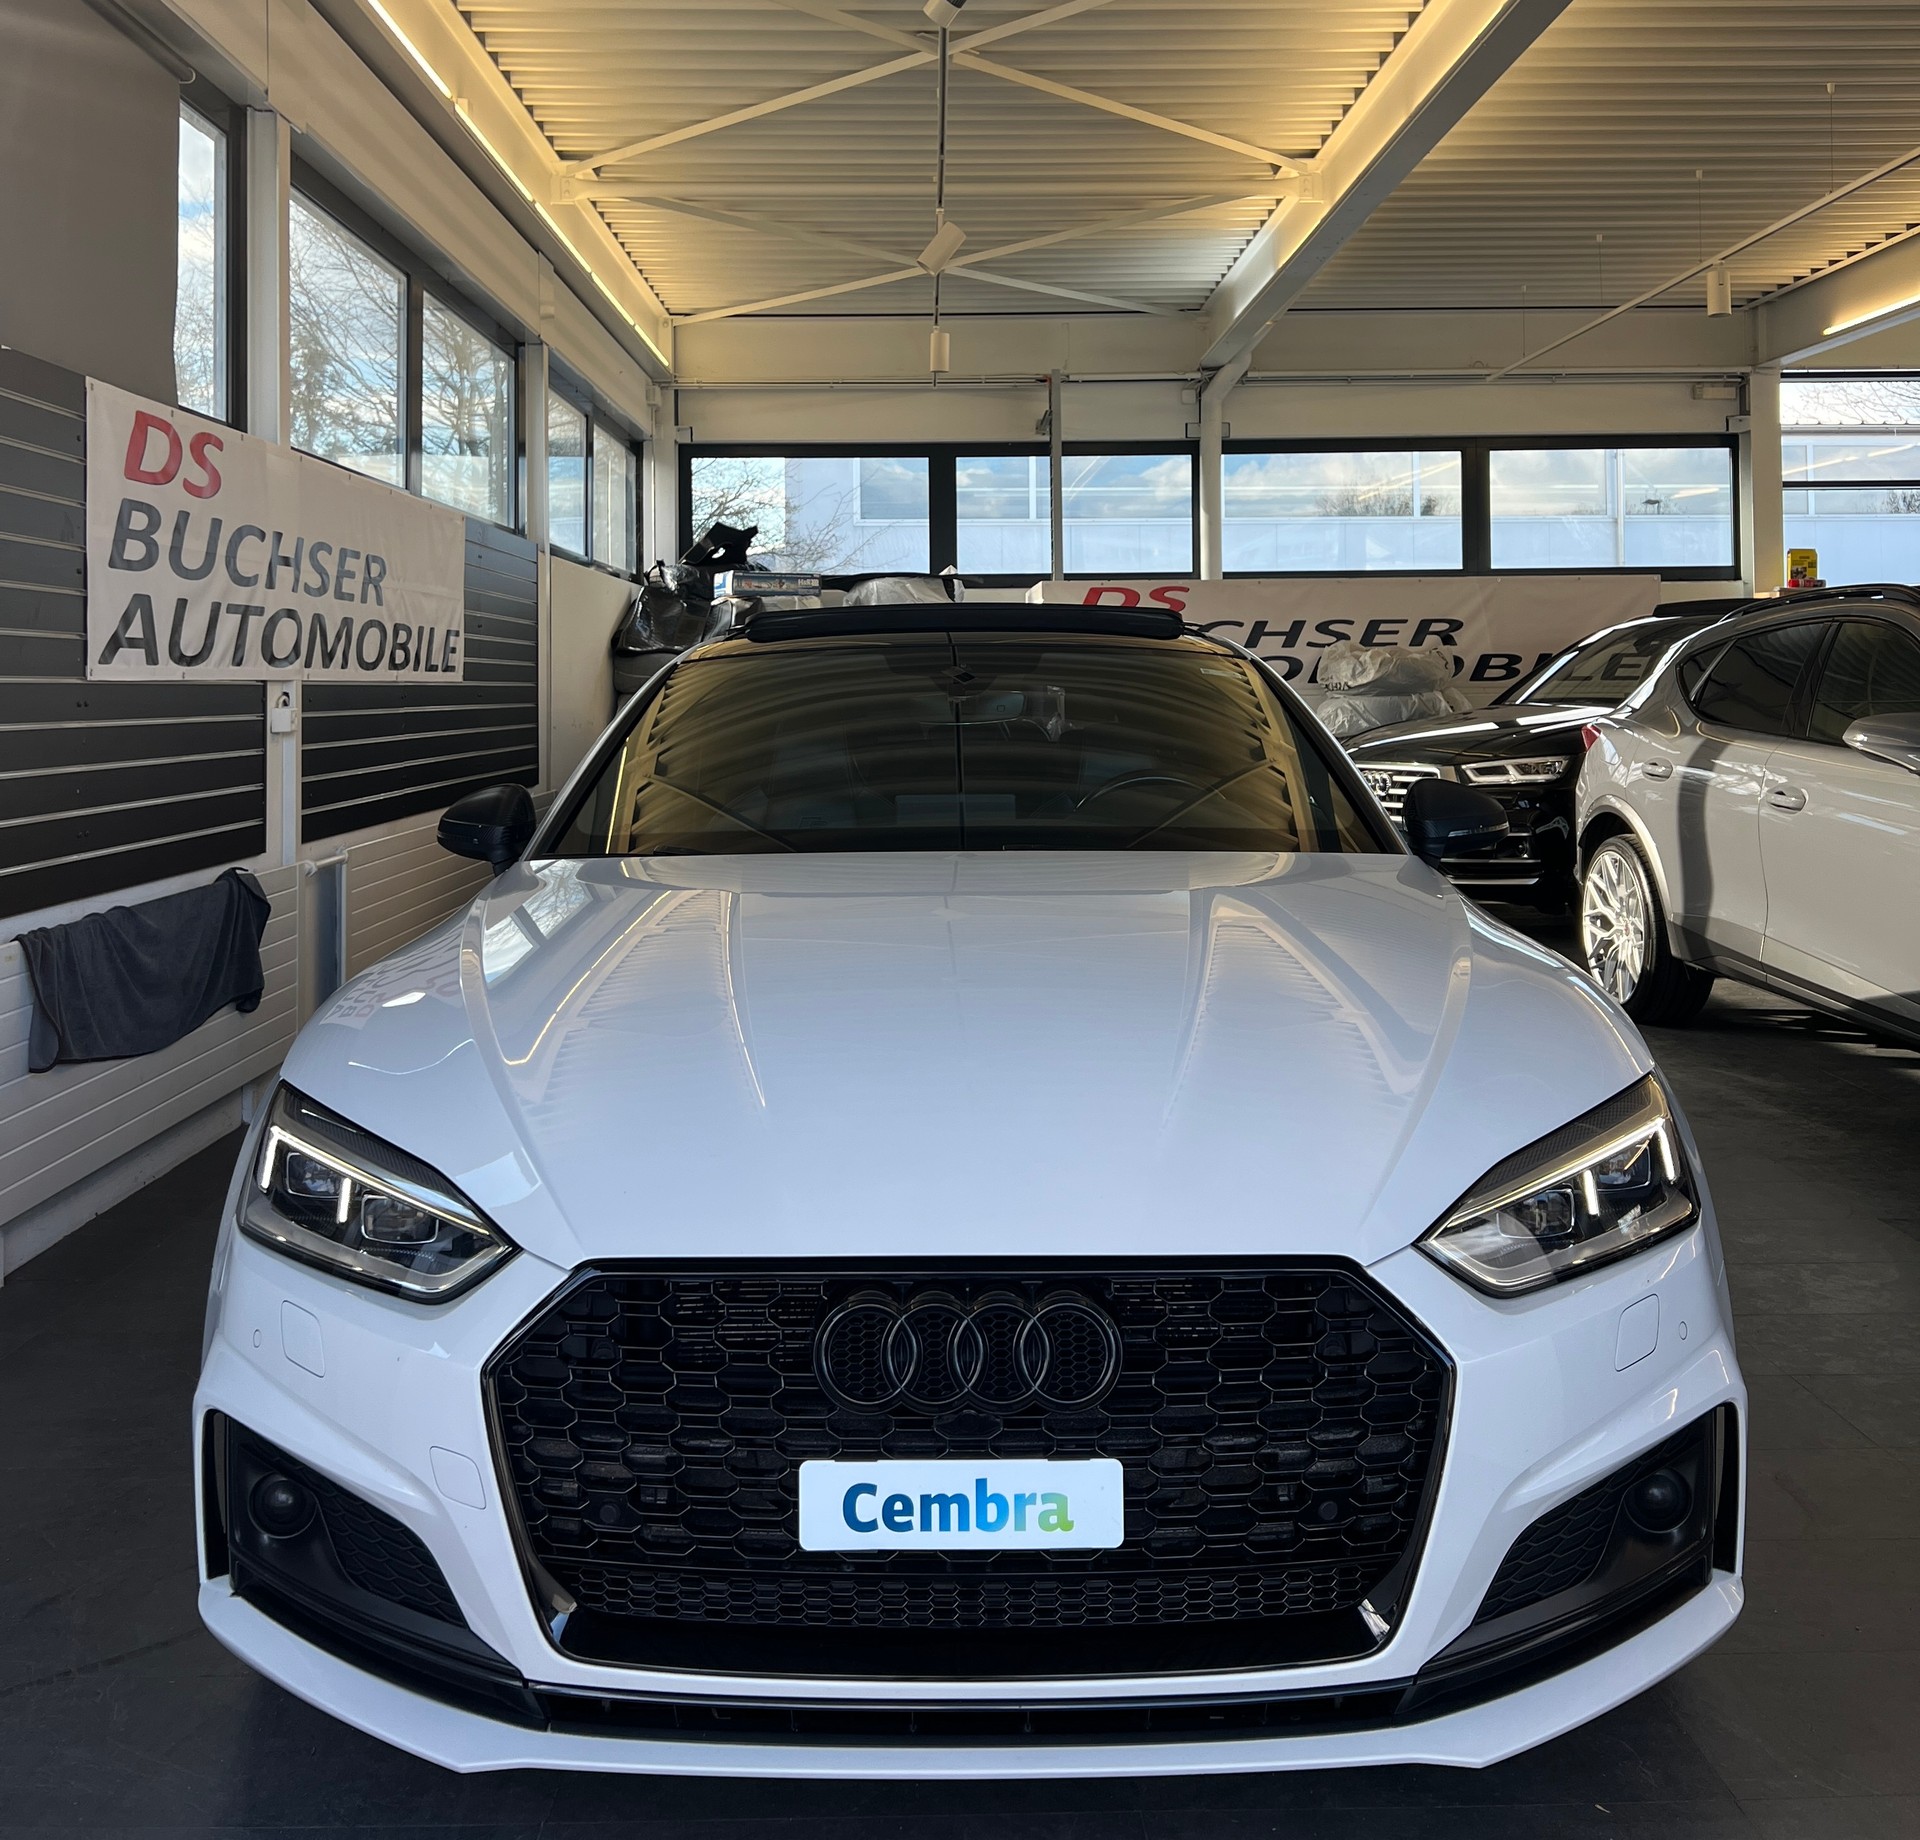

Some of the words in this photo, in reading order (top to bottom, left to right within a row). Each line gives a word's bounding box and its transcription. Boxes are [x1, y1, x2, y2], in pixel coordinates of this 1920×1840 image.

[124, 410, 224, 498] DS
[108, 499, 387, 606] BUCHSER
[98, 593, 460, 673] AUTOMOBILE
[1083, 585, 1190, 613] DS
[843, 1478, 1074, 1532] Cembra
